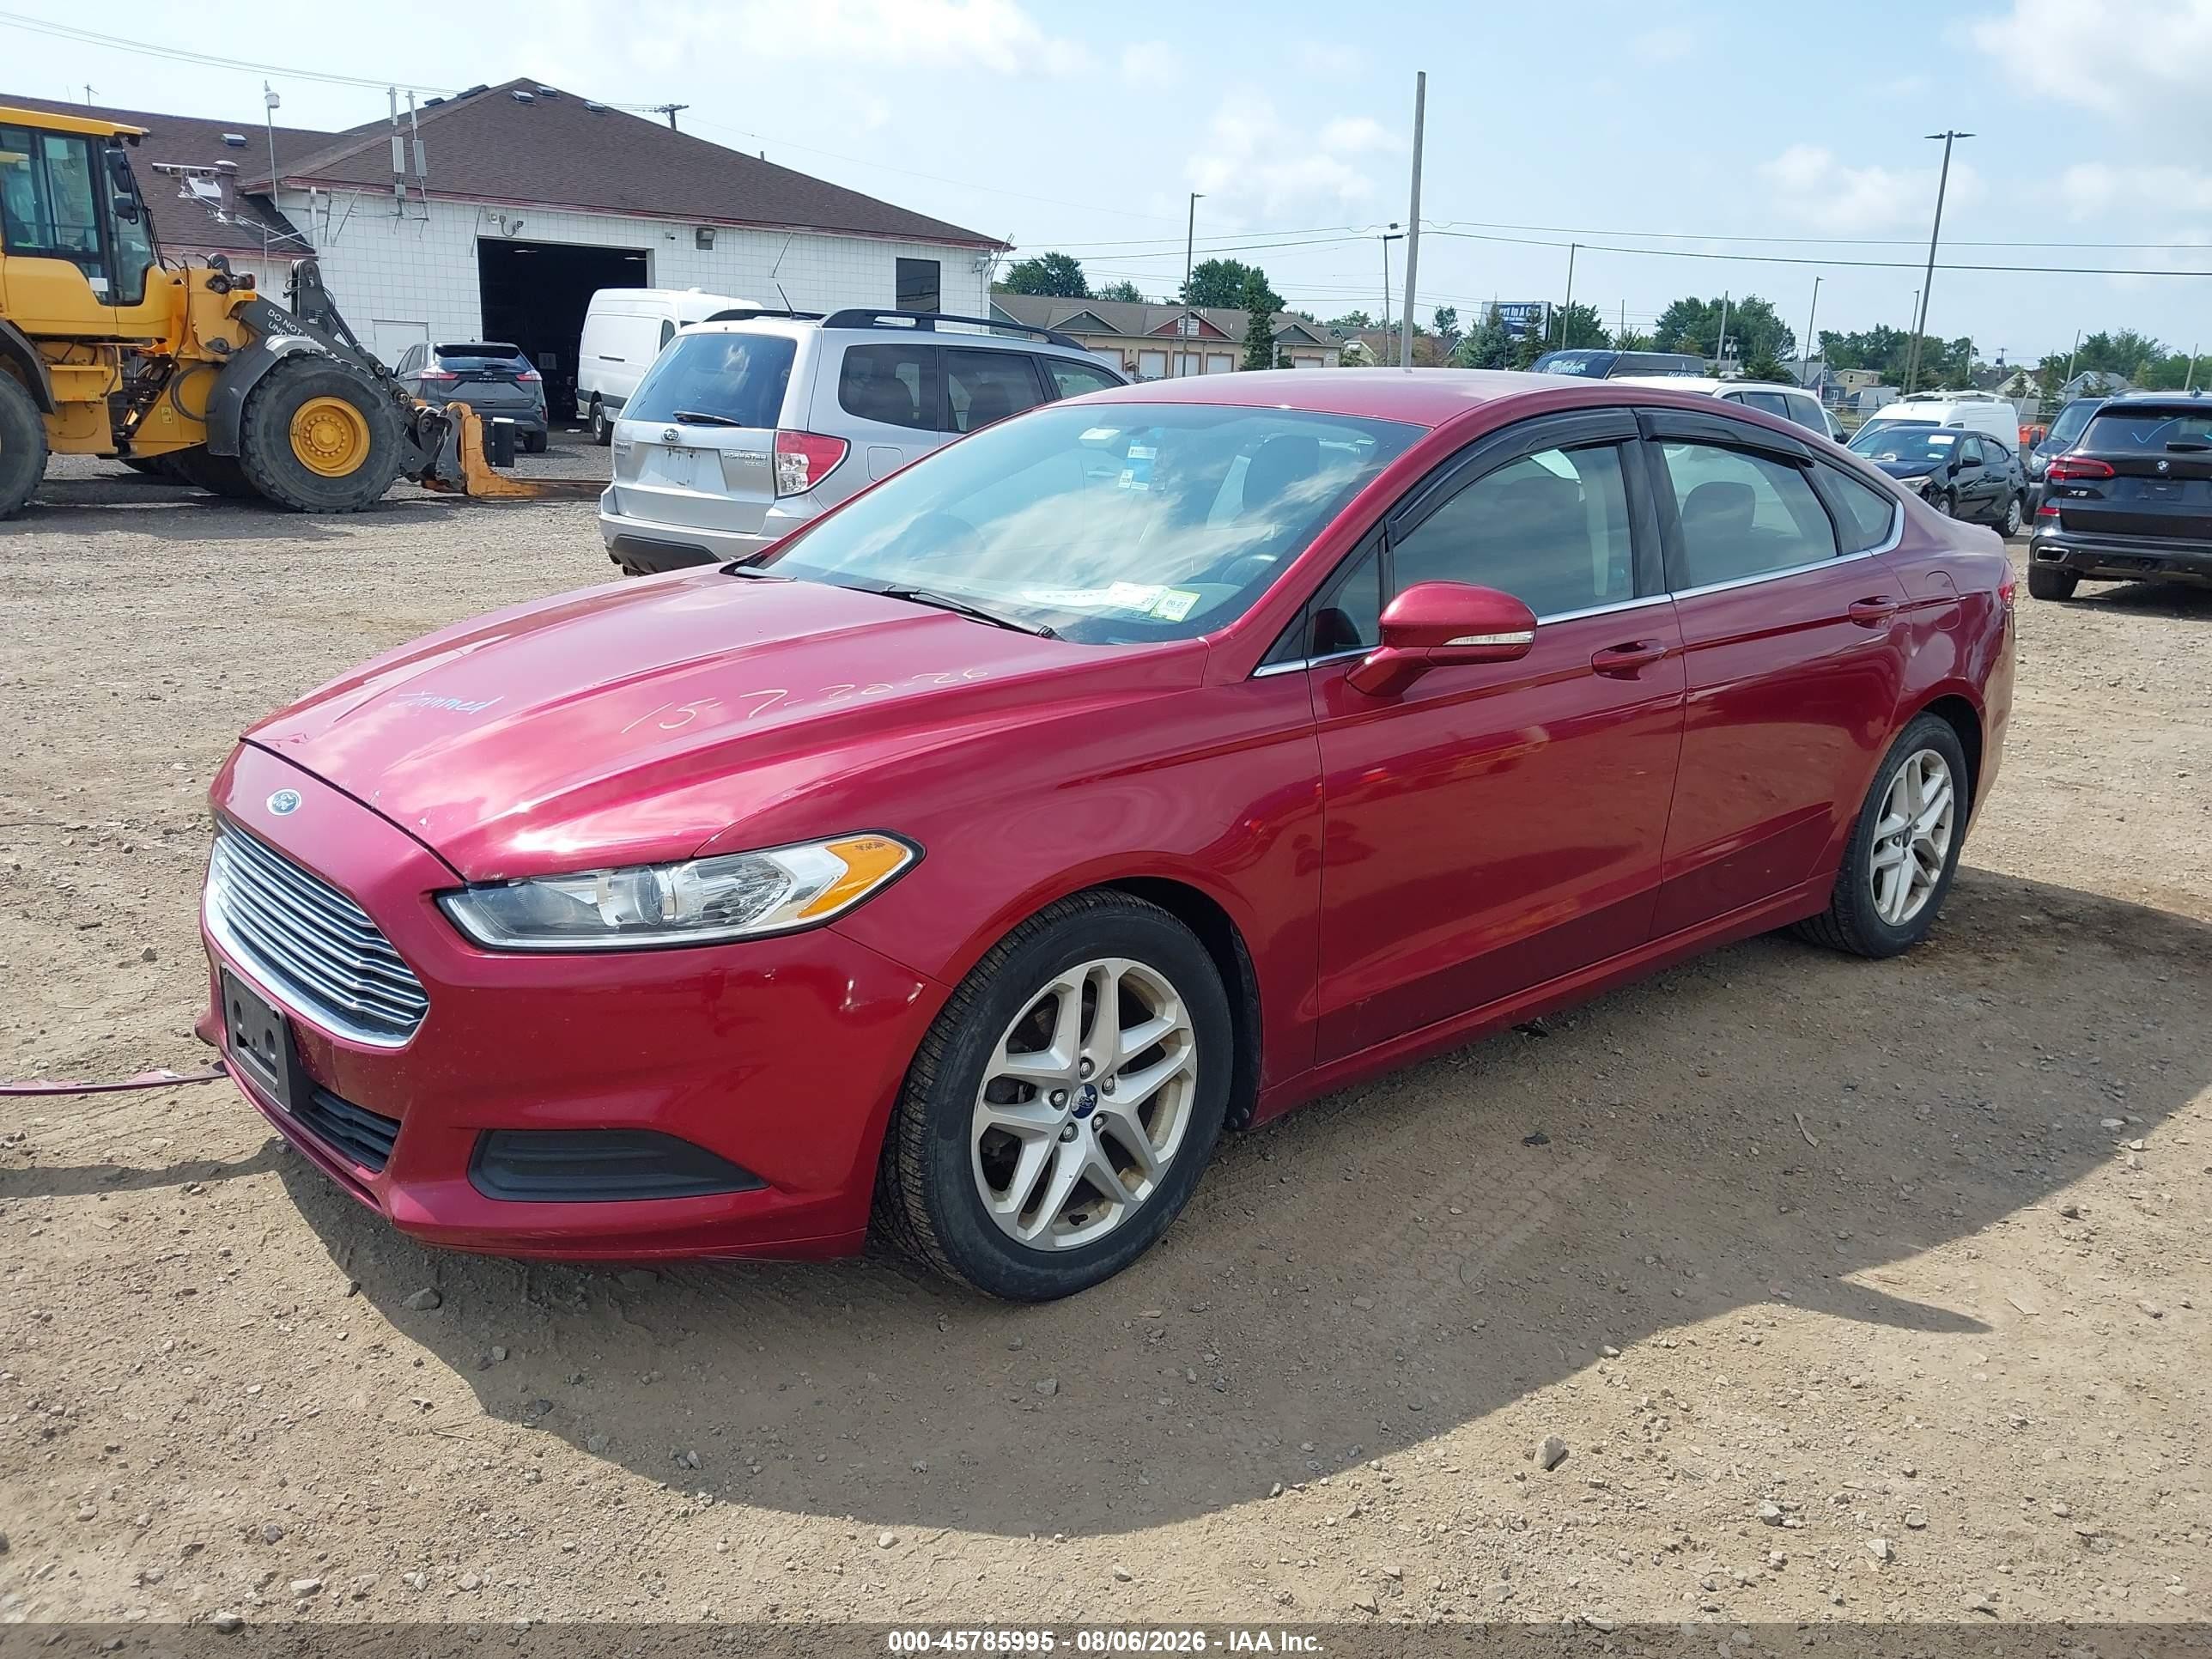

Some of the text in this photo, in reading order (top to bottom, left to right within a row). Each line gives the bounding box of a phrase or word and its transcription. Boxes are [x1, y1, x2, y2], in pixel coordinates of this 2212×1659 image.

[267, 308, 304, 337] DO NOT
[267, 320, 294, 337] UND
[723, 452, 768, 461] FORESTER
[271, 792, 298, 812] Ford
